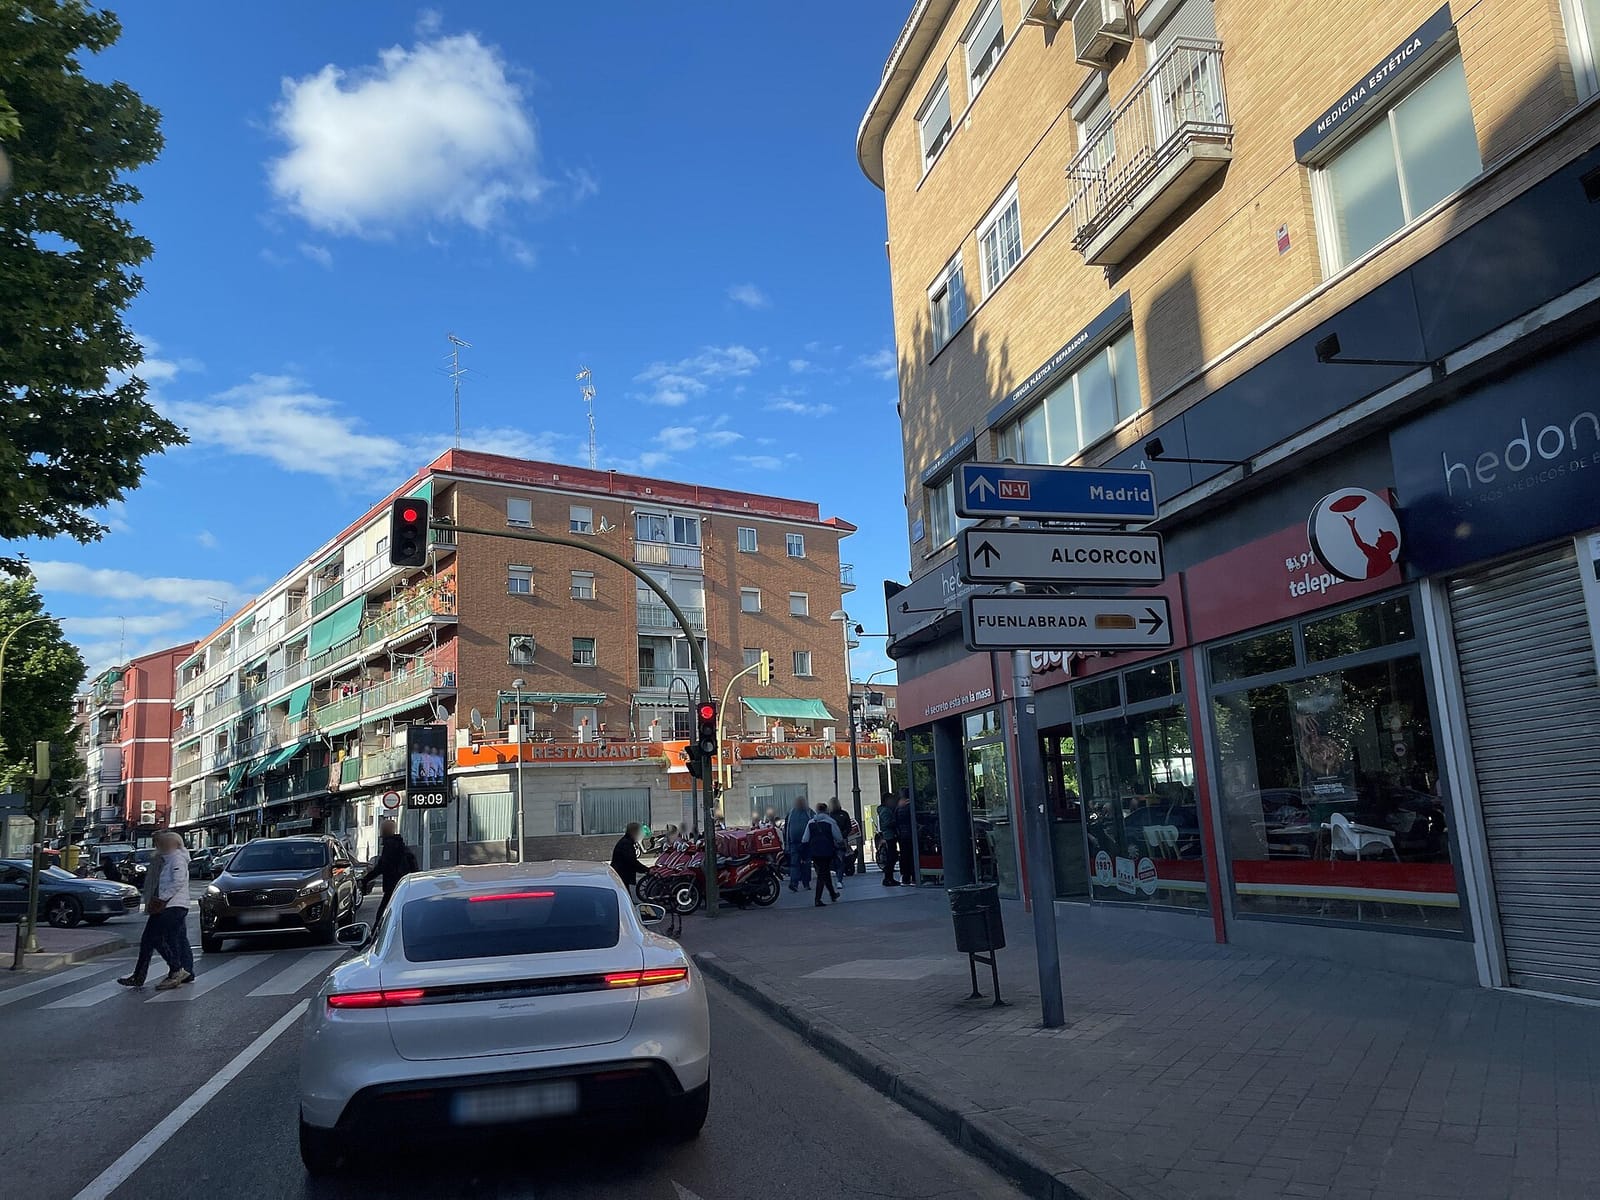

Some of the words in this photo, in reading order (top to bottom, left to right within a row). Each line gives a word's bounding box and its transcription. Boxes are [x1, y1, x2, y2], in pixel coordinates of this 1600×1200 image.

[1317, 86, 1367, 134] MEDICINA
[1368, 38, 1422, 89] ESTÉTICA
[1055, 332, 1089, 364] REPARADORA
[1569, 457, 1589, 472] DE
[1002, 483, 1027, 497] N-V
[1089, 485, 1150, 502] Madrid
[1051, 548, 1157, 565] ALCORCON
[978, 615, 1088, 628] FUENLABRADA
[930, 701, 949, 715] secreto
[961, 695, 969, 705] en
[969, 690, 976, 703] la
[975, 688, 992, 701] masa
[531, 744, 649, 759] RESTAURANTE
[755, 744, 796, 758] CHINO
[411, 793, 443, 806] 19:09
